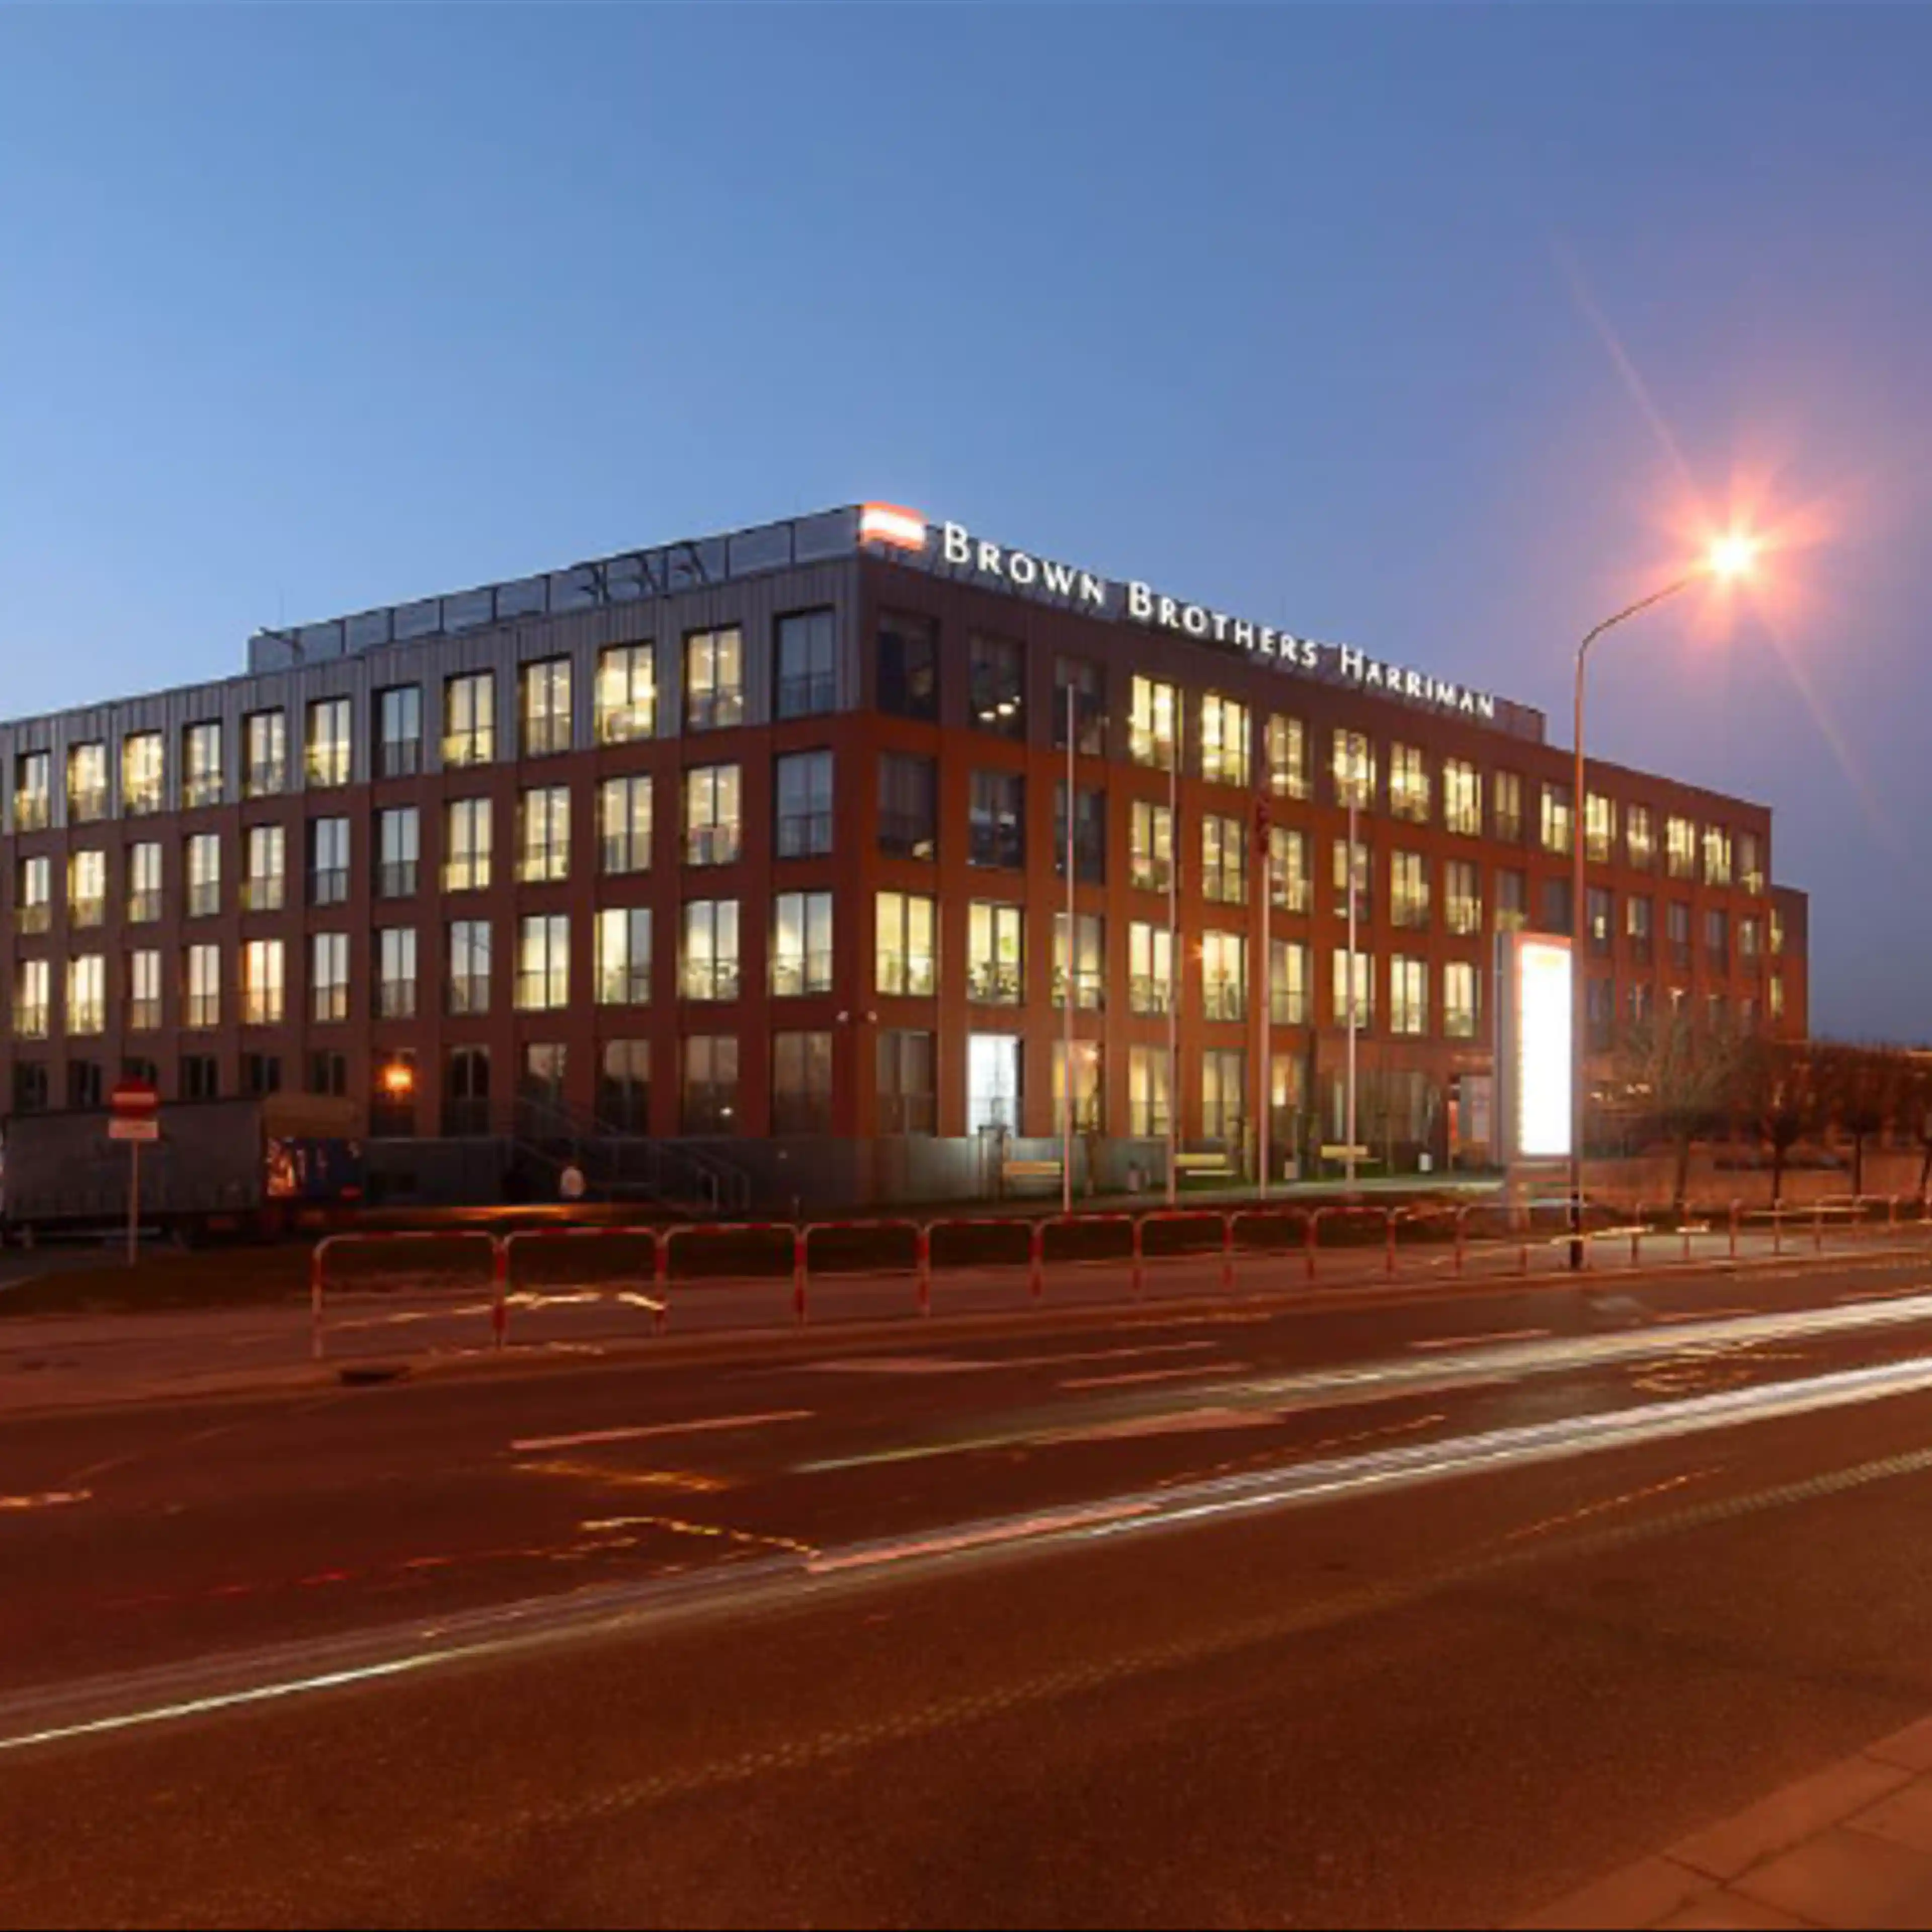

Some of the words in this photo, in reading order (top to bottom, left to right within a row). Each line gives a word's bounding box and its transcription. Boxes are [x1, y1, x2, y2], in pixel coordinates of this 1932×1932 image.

[942, 519, 1104, 605] BROWN
[1128, 580, 1318, 668] BROTHERS
[1340, 642, 1495, 719] HARRIMAN
